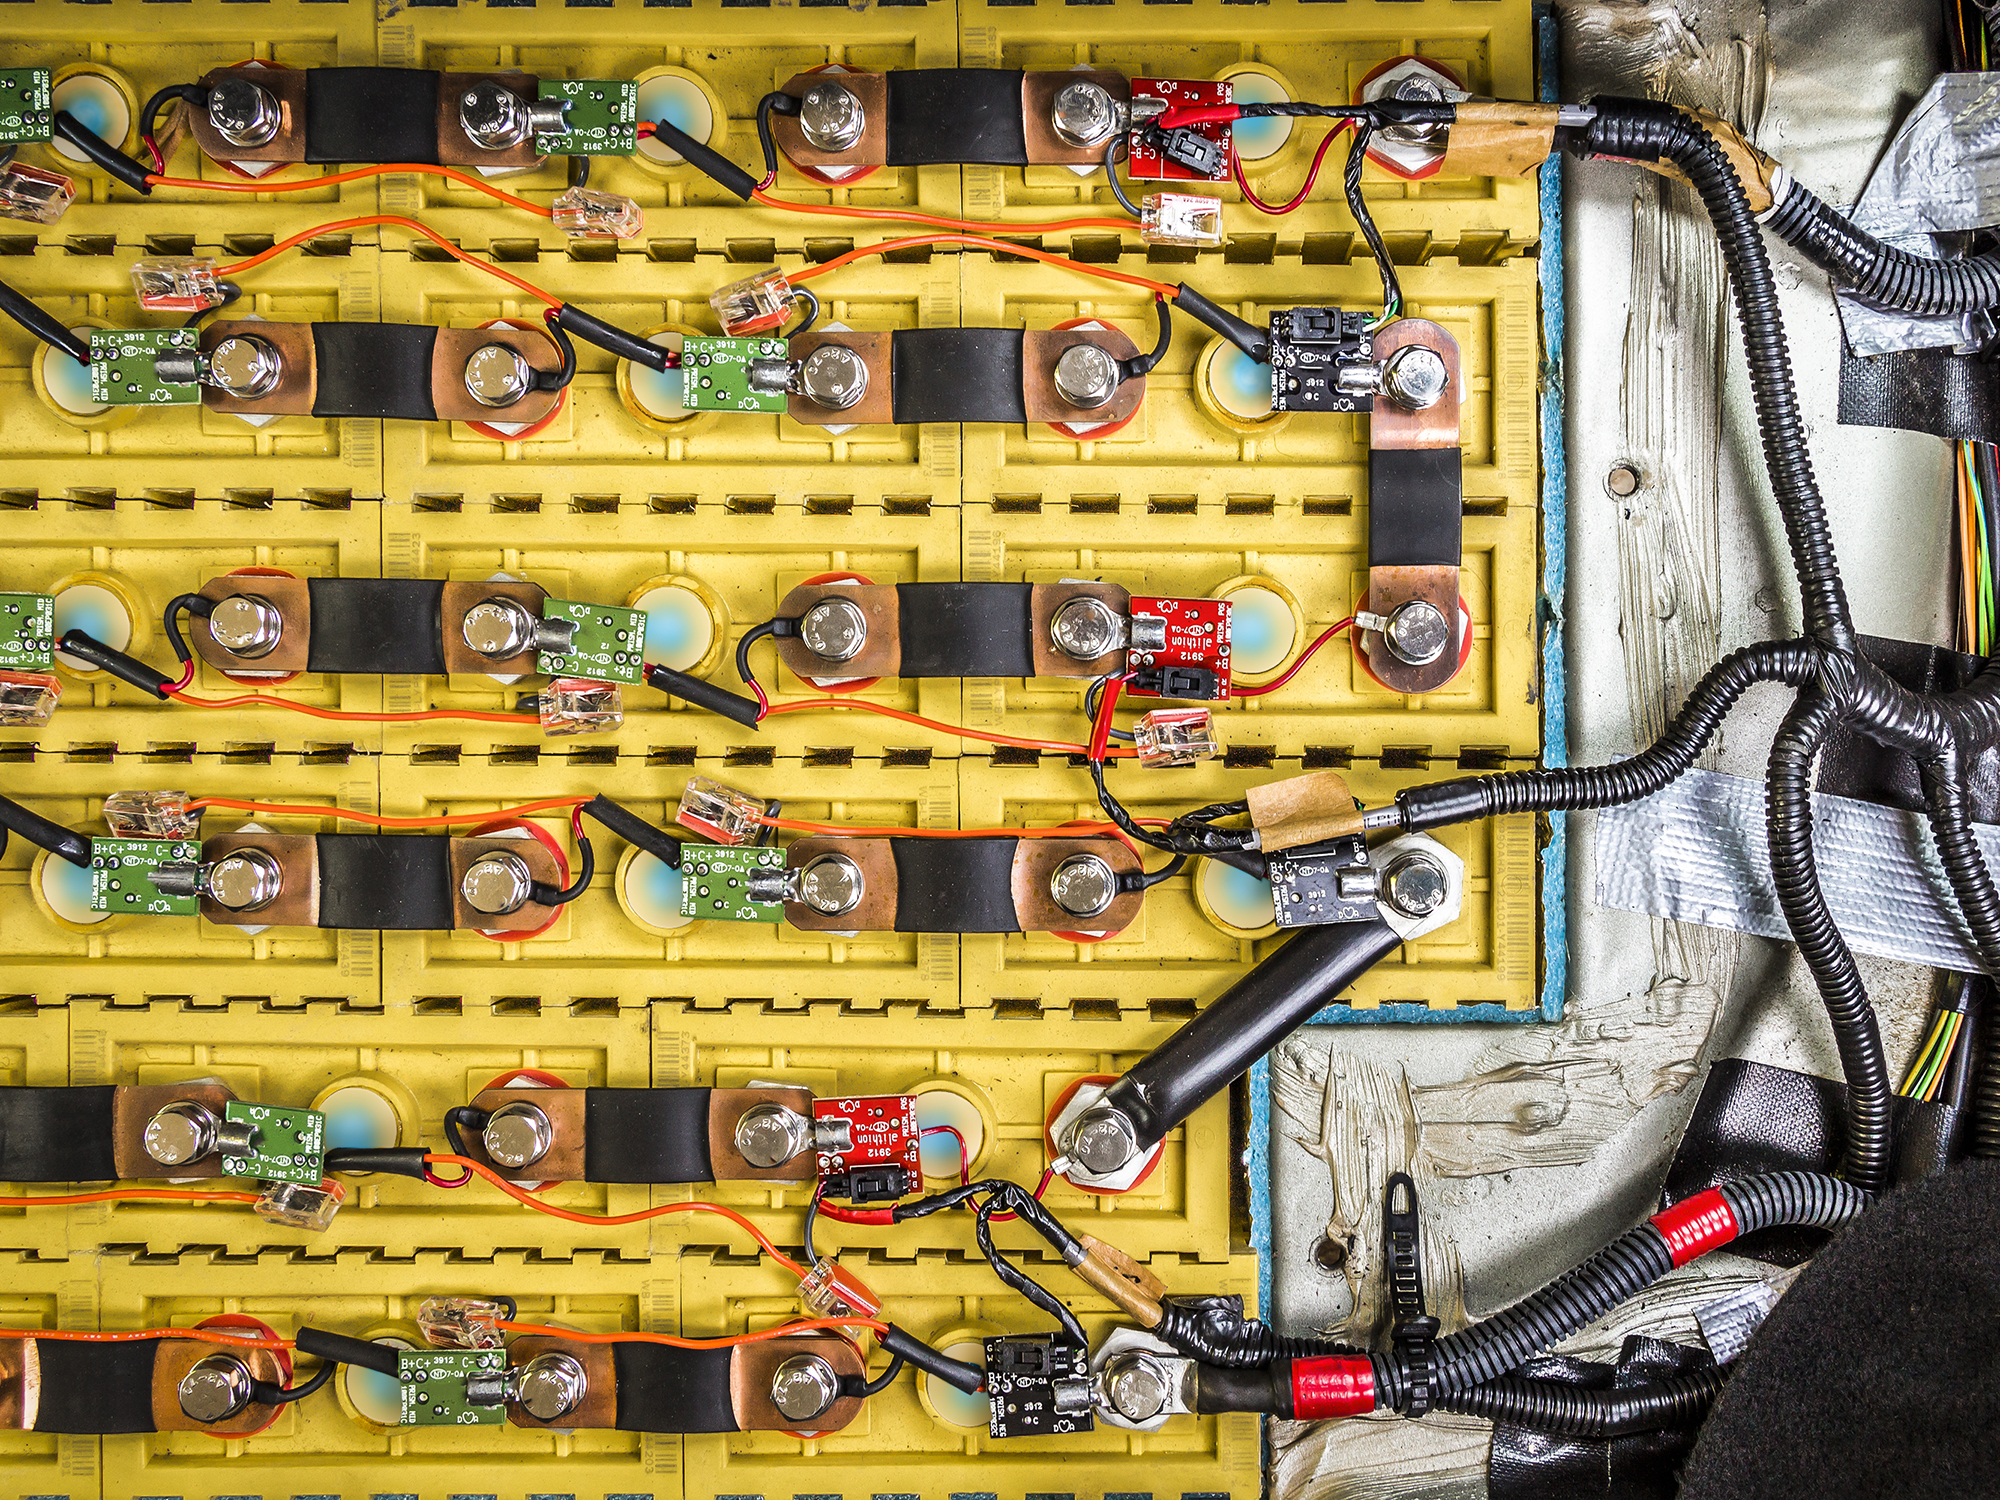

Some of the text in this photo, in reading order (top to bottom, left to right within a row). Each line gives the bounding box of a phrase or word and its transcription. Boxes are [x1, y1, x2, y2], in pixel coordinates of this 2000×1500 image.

[20, 126, 34, 136] C+
[37, 126, 50, 136] B+
[604, 138, 617, 149] C+
[620, 138, 633, 149] B+
[91, 336, 105, 347] B+
[108, 336, 123, 347] C+
[156, 335, 169, 345] C-
[684, 341, 697, 352] B+
[700, 342, 715, 352] C+
[747, 343, 759, 354] C-
[1306, 379, 1324, 387] 3912
[100, 388, 108, 401] MID
[627, 630, 635, 652] PRISM.
[1171, 637, 1212, 650] alithion
[20, 652, 34, 662] C+
[37, 653, 50, 663] B+
[1181, 652, 1204, 660] 3912
[1215, 659, 1228, 669] B+
[586, 668, 606, 676] 3912
[94, 843, 107, 854] B+
[109, 844, 124, 854] C+
[127, 843, 147, 851] 3912
[156, 845, 168, 856] C-
[1353, 842, 1364, 852] B-
[683, 850, 697, 860] B+
[698, 850, 712, 861] C+
[715, 850, 735, 858] 3912
[743, 852, 755, 863] C-
[99, 870, 108, 909] PRISM. MID
[1308, 890, 1326, 899] 3912
[305, 1132, 313, 1154] PRISM.
[857, 1133, 898, 1145] alithion
[868, 1149, 891, 1157] 3912
[903, 1151, 917, 1161] B+
[250, 1164, 261, 1174] C-
[268, 1169, 287, 1178] 3912
[290, 1168, 303, 1179] C+
[305, 1170, 317, 1181] B+
[401, 1359, 415, 1369] B+
[416, 1358, 431, 1369] C+
[462, 1357, 474, 1368] C-
[988, 1373, 1002, 1383] B+
[997, 1396, 1005, 1420] PRISM.
[1024, 1402, 1042, 1411] 3912
